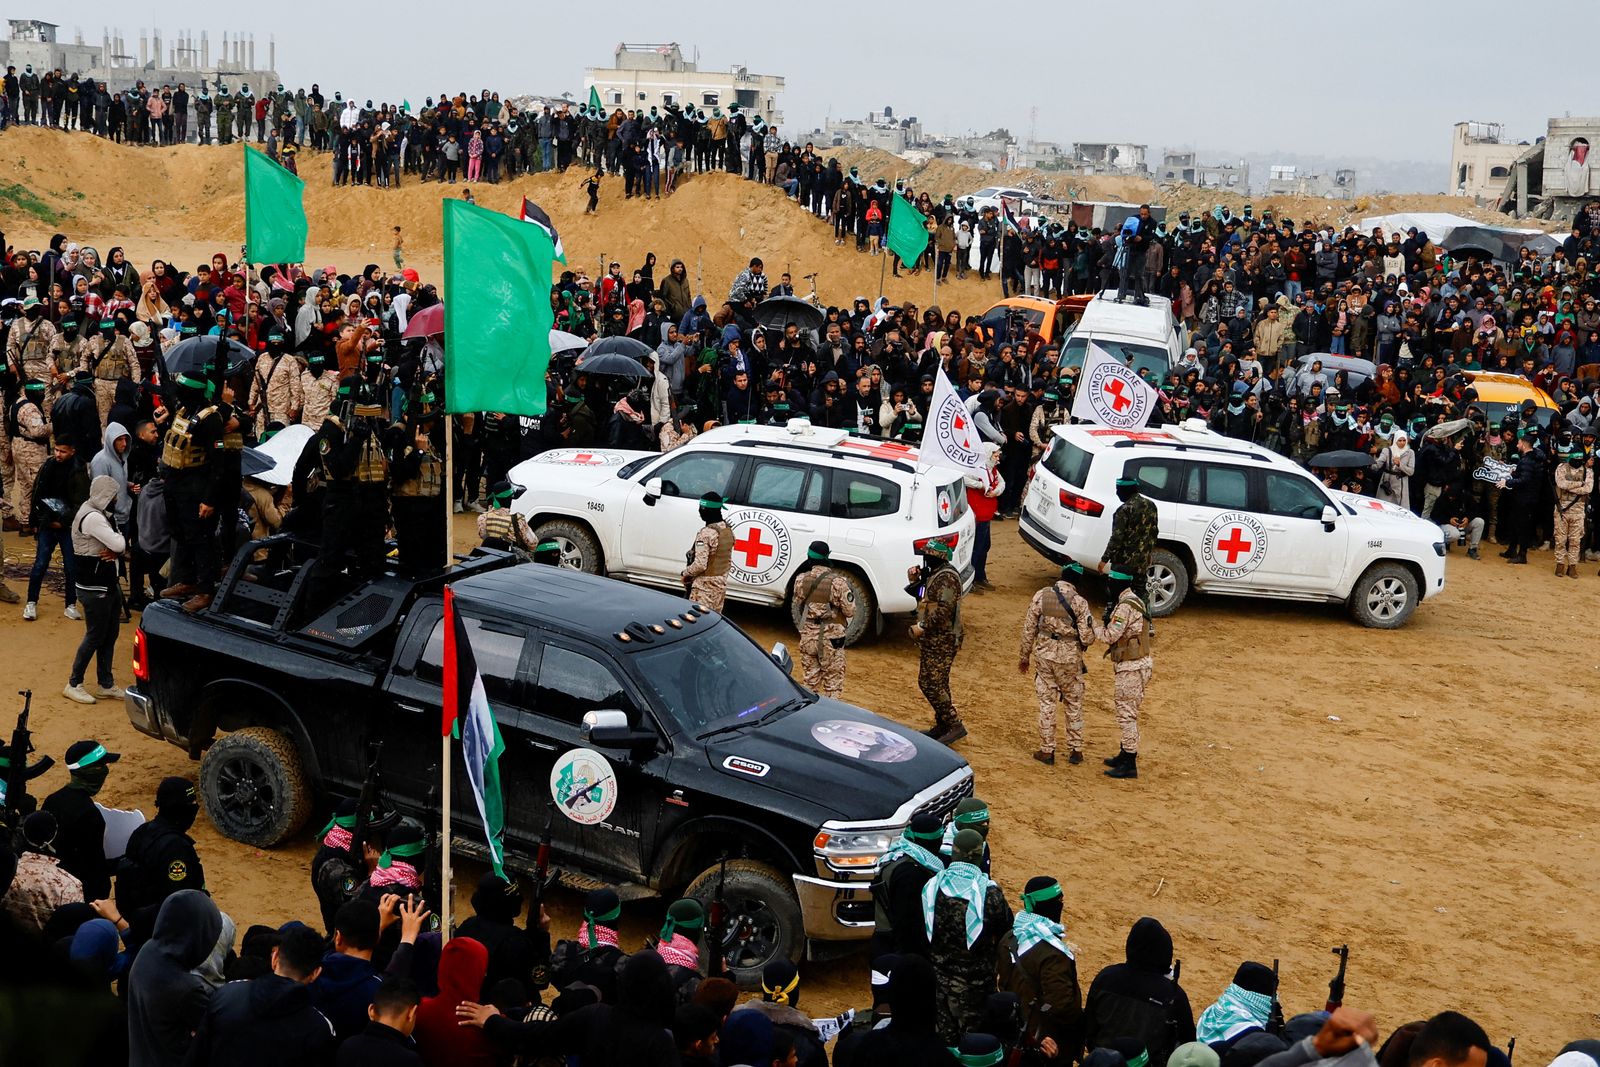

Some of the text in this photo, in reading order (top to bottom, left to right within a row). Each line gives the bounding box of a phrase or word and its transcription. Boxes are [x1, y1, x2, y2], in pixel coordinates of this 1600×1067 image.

[946, 444, 975, 465] GENE
[587, 501, 605, 513] 18450
[739, 511, 789, 572] INTERNATIONAL
[1203, 513, 1266, 564] COMITE INTERNATIONAL
[1367, 540, 1383, 548] 18448
[729, 565, 772, 583] GENEVE
[1210, 564, 1249, 578] GENEVE
[732, 759, 762, 771] 2500
[600, 821, 640, 838] RAM
